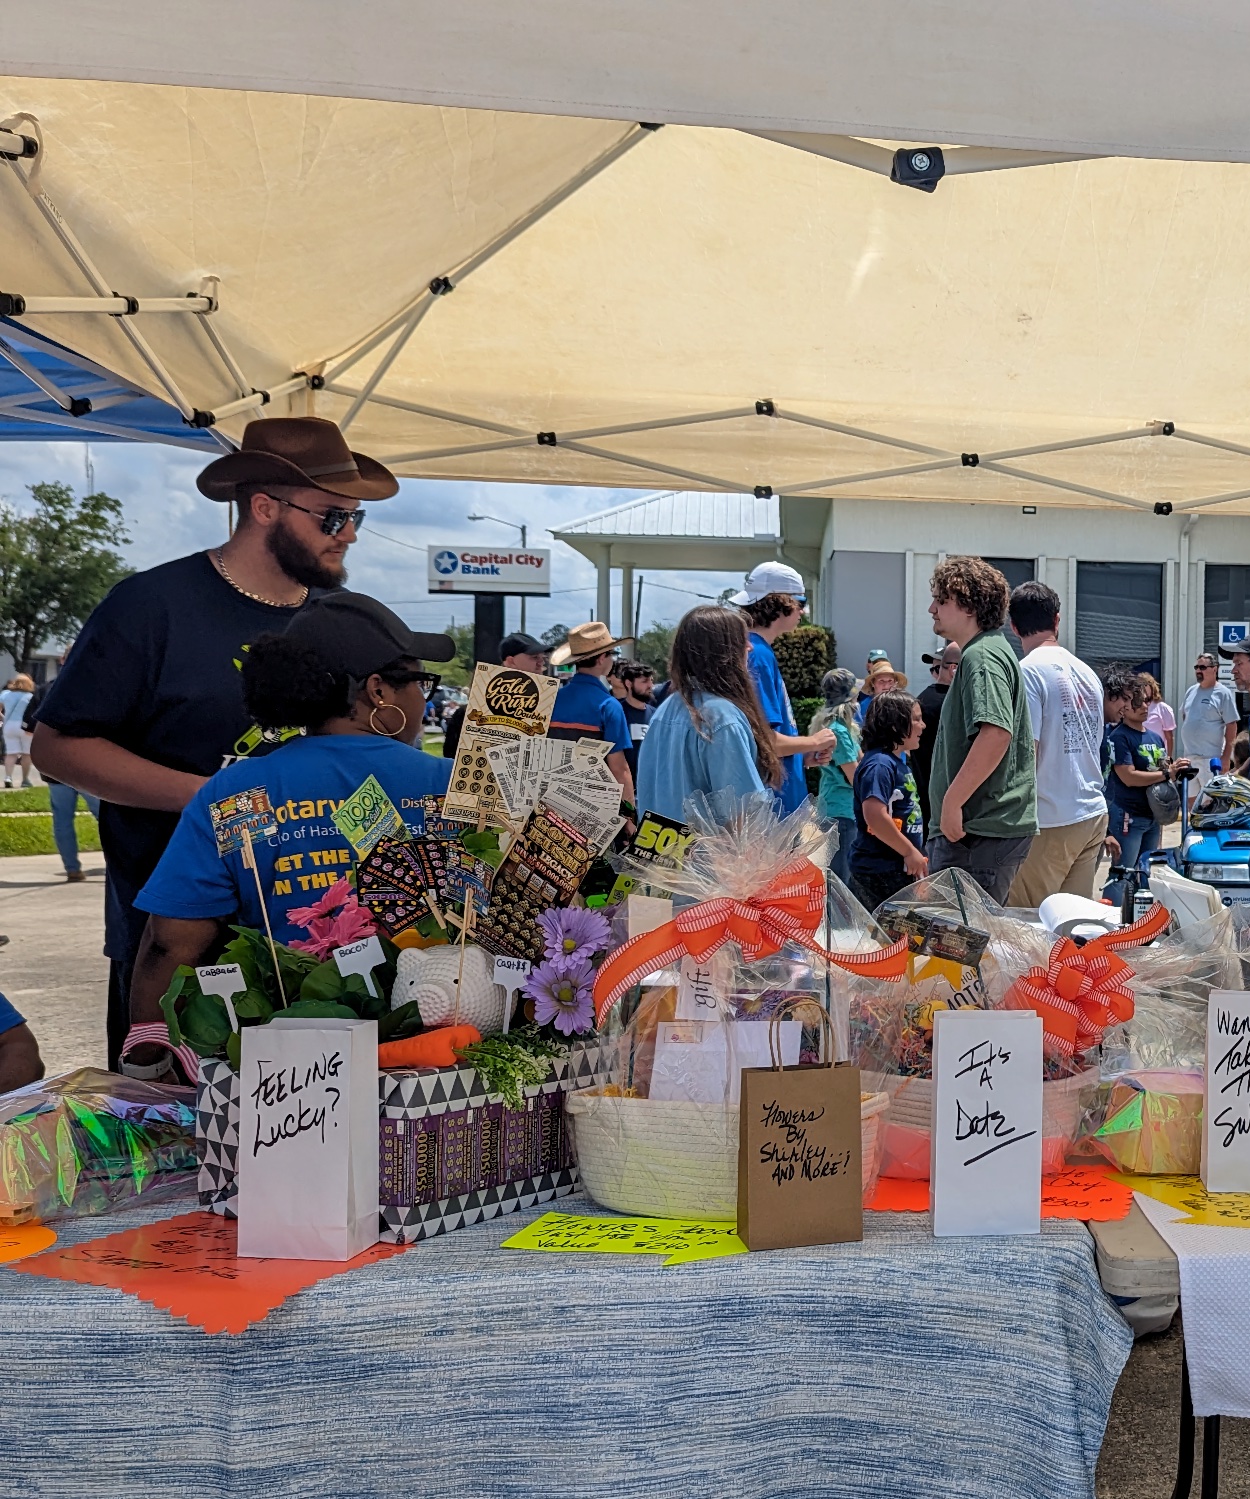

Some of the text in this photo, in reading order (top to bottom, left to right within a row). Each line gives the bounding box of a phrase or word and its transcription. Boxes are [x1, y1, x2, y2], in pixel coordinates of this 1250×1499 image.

[460, 552, 544, 568] Capital City
[461, 564, 501, 575] Bank
[486, 678, 528, 699] Gold
[491, 694, 540, 715] Rush
[514, 708, 547, 722] Doubler
[271, 798, 425, 825] otary Dist
[294, 826, 306, 840] of
[534, 815, 590, 863] GOLD
[274, 849, 351, 873] ET THE
[526, 824, 583, 876] RUSH
[539, 850, 575, 882] LEGACY
[274, 873, 344, 896] N THE
[694, 969, 717, 1010] gift
[251, 1051, 344, 1110] FEELING
[980, 1067, 993, 1090] A
